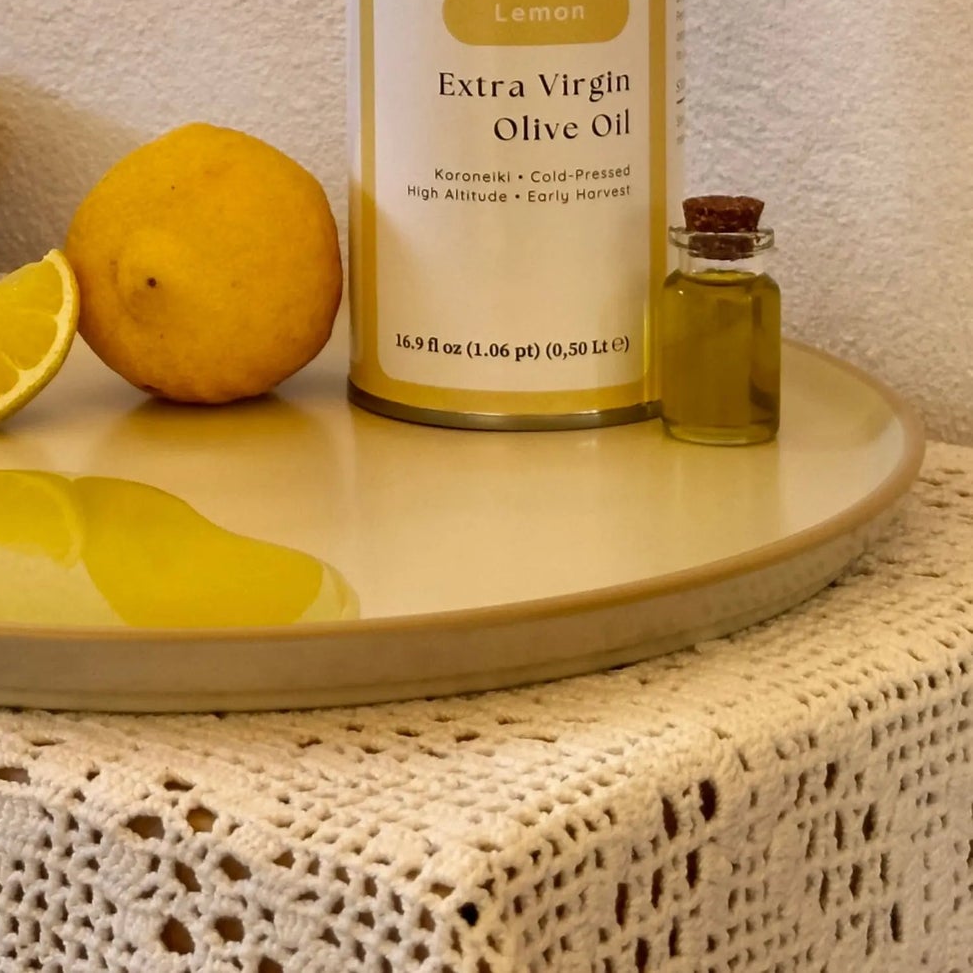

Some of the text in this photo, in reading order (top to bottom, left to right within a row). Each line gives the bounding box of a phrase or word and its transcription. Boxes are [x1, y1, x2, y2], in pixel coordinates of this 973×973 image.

[494, 2, 585, 22] Lemon
[438, 70, 630, 103] Extra Virgin
[493, 108, 630, 142] Olive Oil
[434, 164, 631, 184] Koroneiki Cold-Pressed
[407, 184, 630, 205] High Altitude Early Harvest
[395, 333, 425, 351] 16.9
[427, 336, 440, 354] fl
[442, 342, 463, 356] oz
[466, 340, 510, 359] (1.06
[514, 342, 541, 363] pt)
[545, 341, 588, 361] (0,50
[591, 339, 609, 355] Lt
